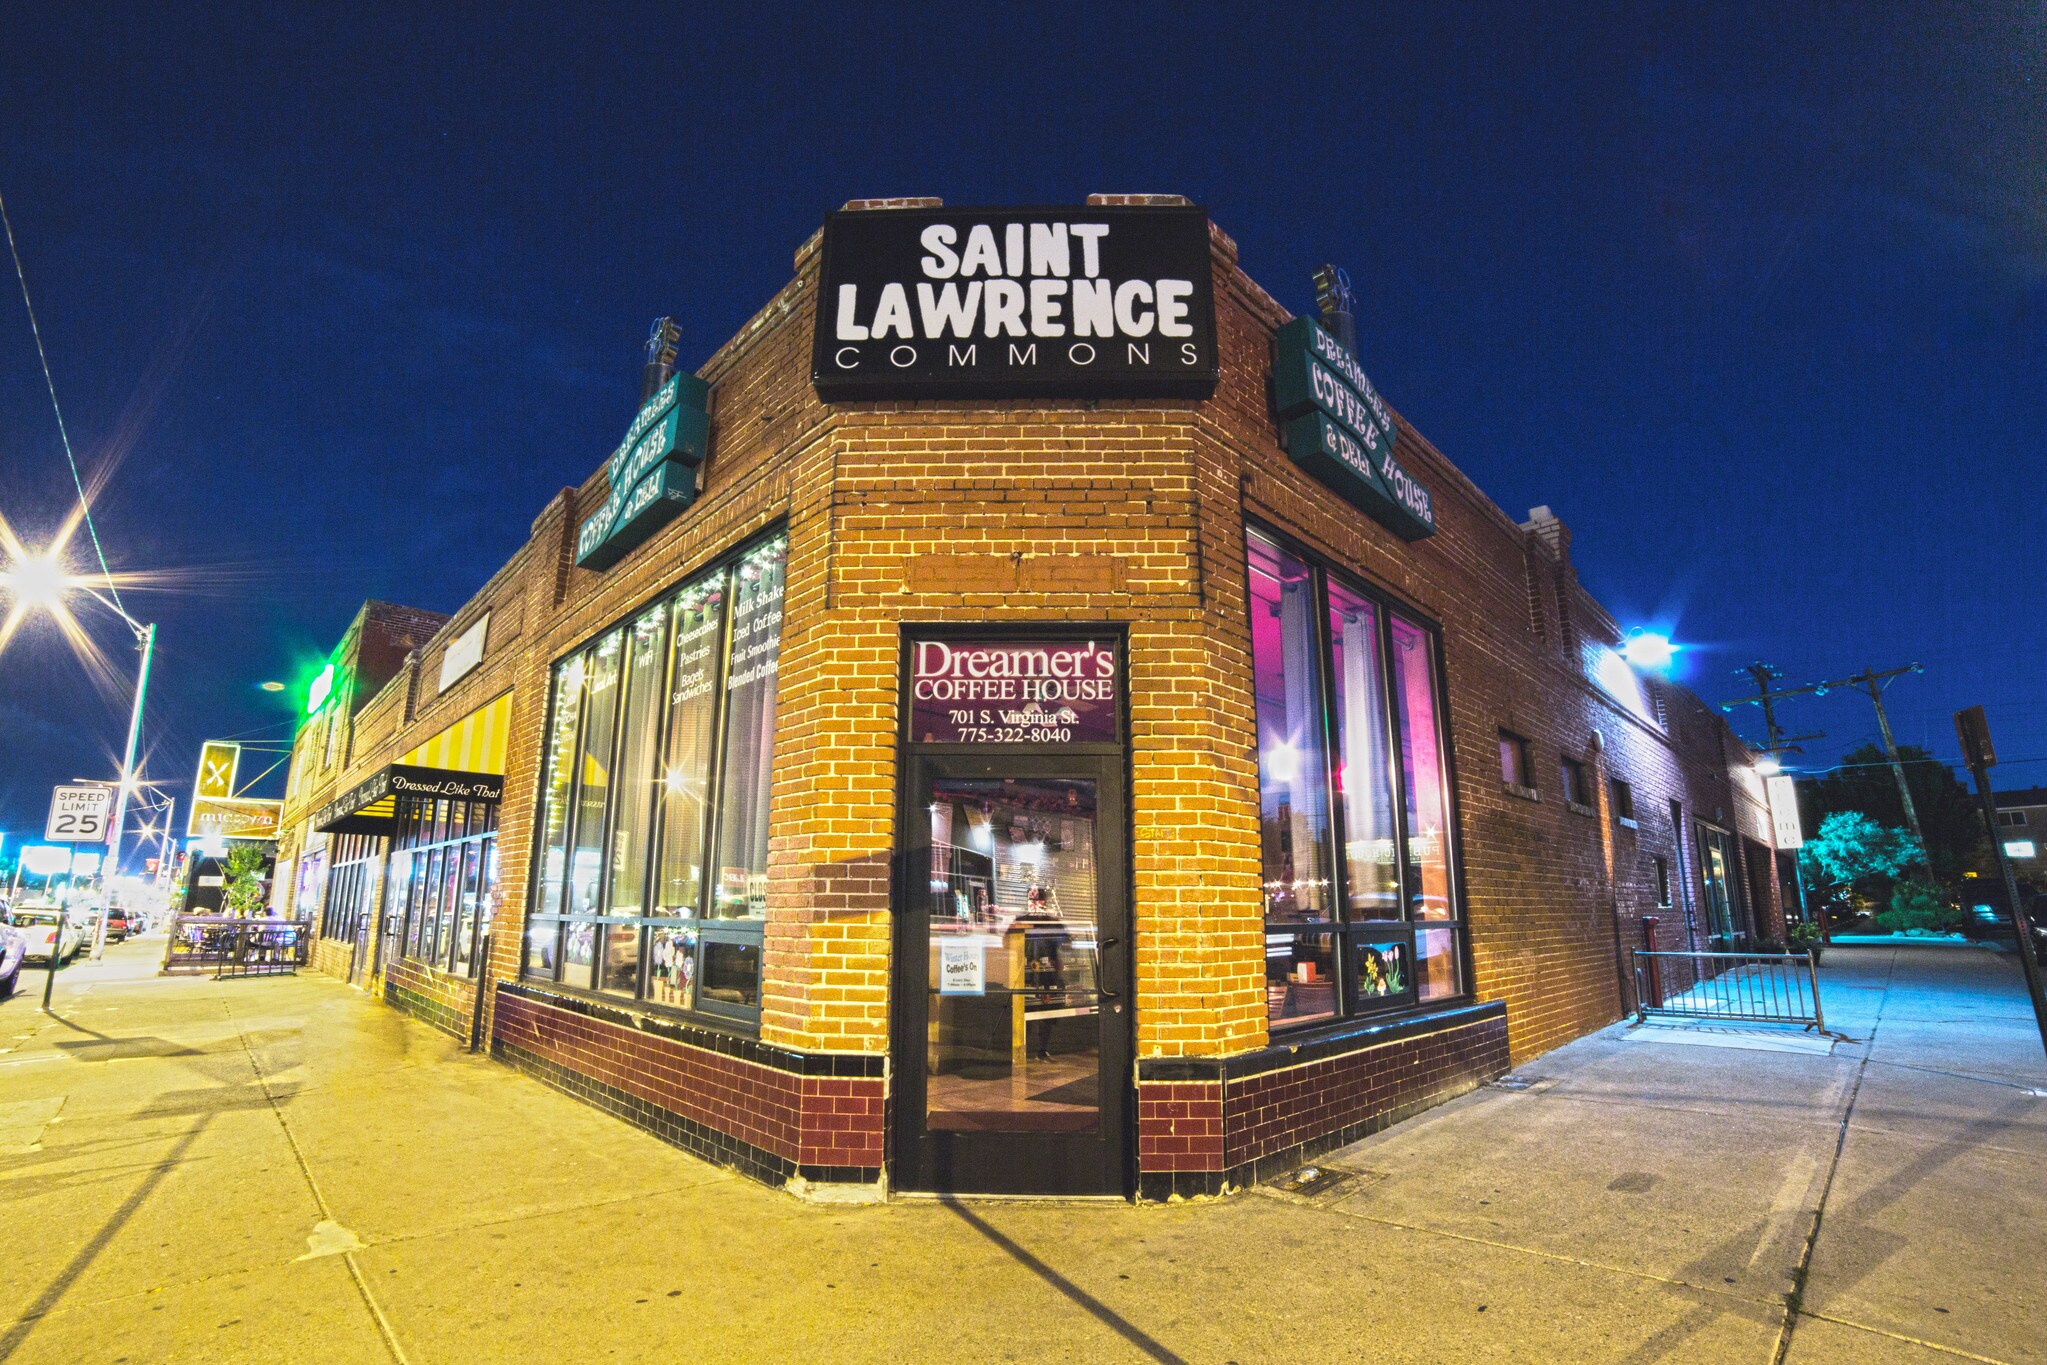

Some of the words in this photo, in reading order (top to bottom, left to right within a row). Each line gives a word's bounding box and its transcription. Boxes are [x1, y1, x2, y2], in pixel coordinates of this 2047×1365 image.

[920, 222, 1110, 279] SAINT
[836, 279, 1194, 341] LAWRENCE
[835, 343, 1198, 369] COMMONS
[1315, 327, 1391, 432] DREAMERS
[1312, 361, 1380, 450] COFFEE
[1381, 452, 1432, 524] HOUSE
[1338, 431, 1372, 480] DELI
[579, 482, 621, 556] COFFEE
[622, 419, 668, 497] HOUSE
[633, 469, 662, 513] DELI
[733, 597, 755, 620] Milk
[756, 585, 785, 609] Shake
[676, 619, 719, 647] Cheesecakes
[733, 622, 750, 643] Iced
[753, 610, 783, 633] Coffee
[680, 645, 711, 668] Pastries
[730, 648, 746, 666] Fruit
[914, 640, 1115, 678] Dreamer's
[681, 668, 705, 688] Bagels
[728, 667, 755, 690] Blended
[914, 679, 1016, 701] COFFEE
[1021, 679, 1114, 701] HOUSE
[672, 680, 713, 705] Sandwiches
[949, 710, 975, 725] 701
[980, 710, 994, 724] S.
[998, 710, 1057, 728] Virginia
[1060, 710, 1080, 724] St.
[957, 728, 1071, 743] 775-322-8040
[58, 792, 105, 802] SPEED
[393, 776, 439, 793] Dressed
[440, 782, 470, 796] Like
[473, 784, 501, 799] That
[61, 803, 99, 812] LIMIT
[55, 814, 98, 834] 25
[946, 962, 969, 974] Coffee's
[969, 961, 977, 972] On
